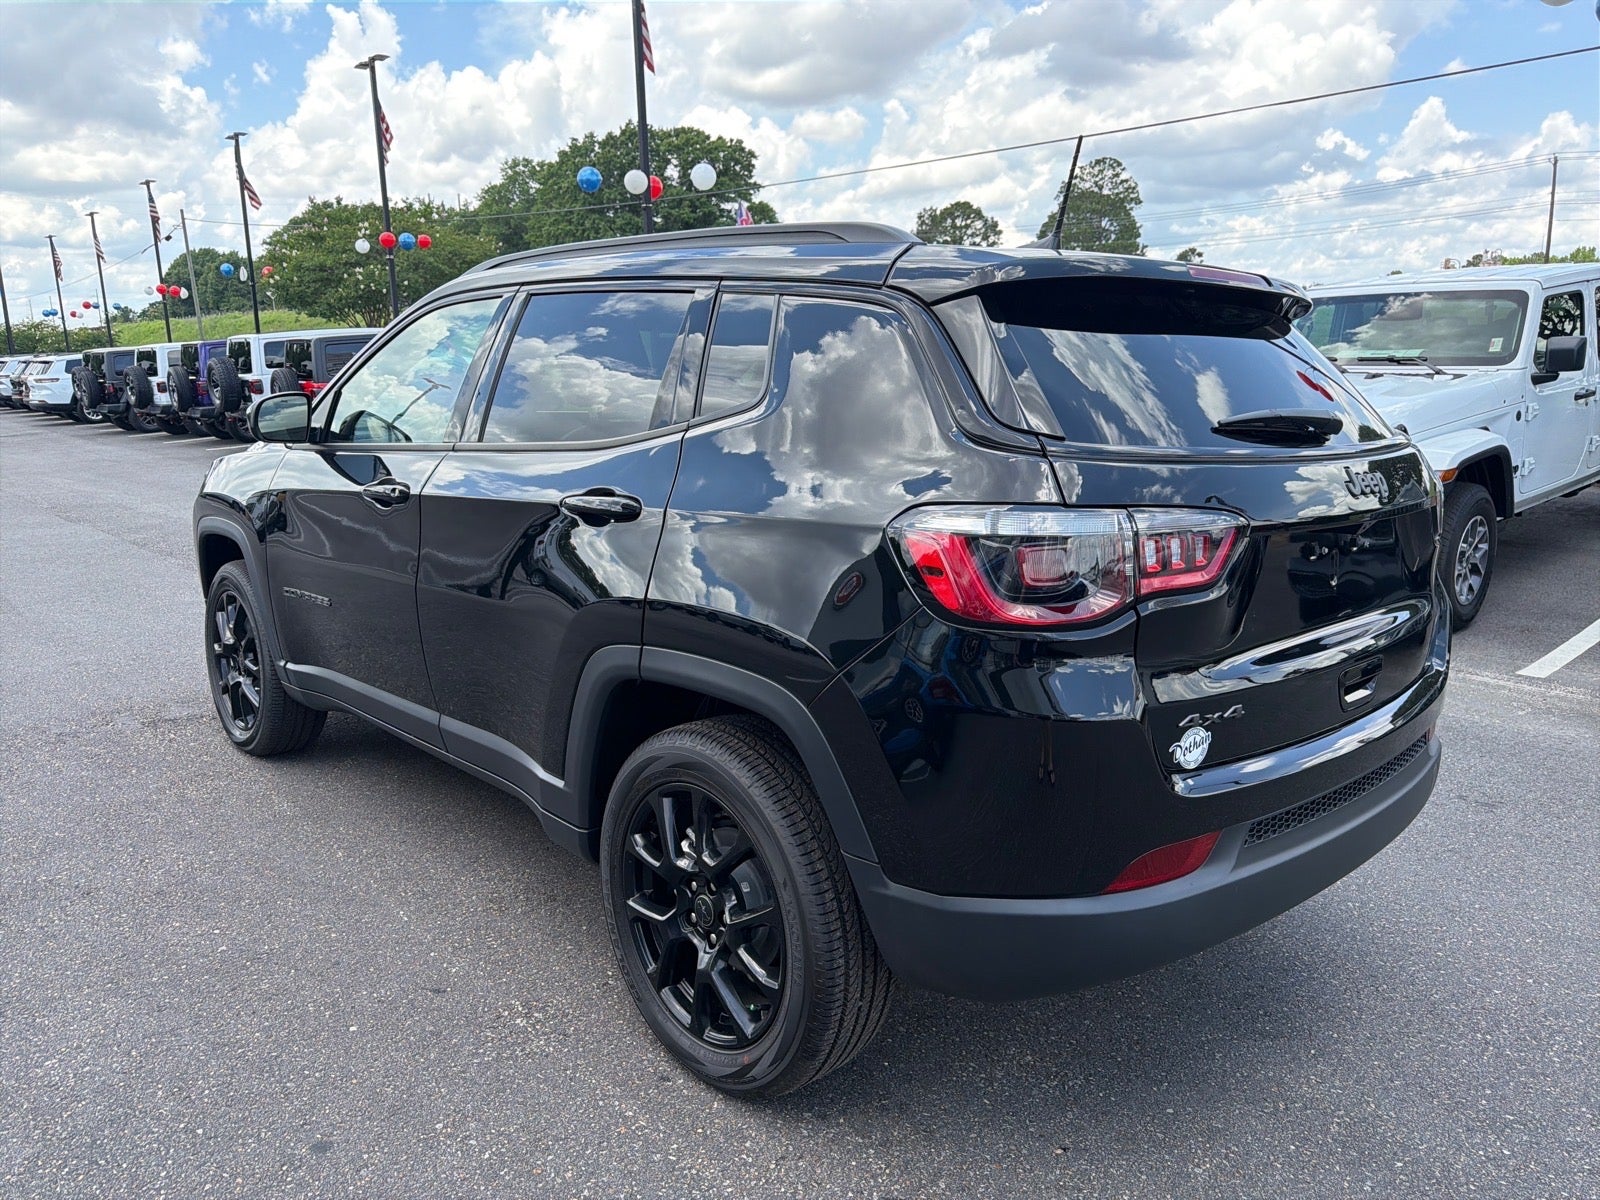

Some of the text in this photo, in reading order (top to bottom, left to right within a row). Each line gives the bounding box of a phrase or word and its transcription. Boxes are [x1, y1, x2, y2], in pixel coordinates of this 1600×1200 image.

[1343, 466, 1389, 502] Jeep
[1178, 704, 1245, 727] 4x4
[1168, 731, 1212, 764] Dothan
